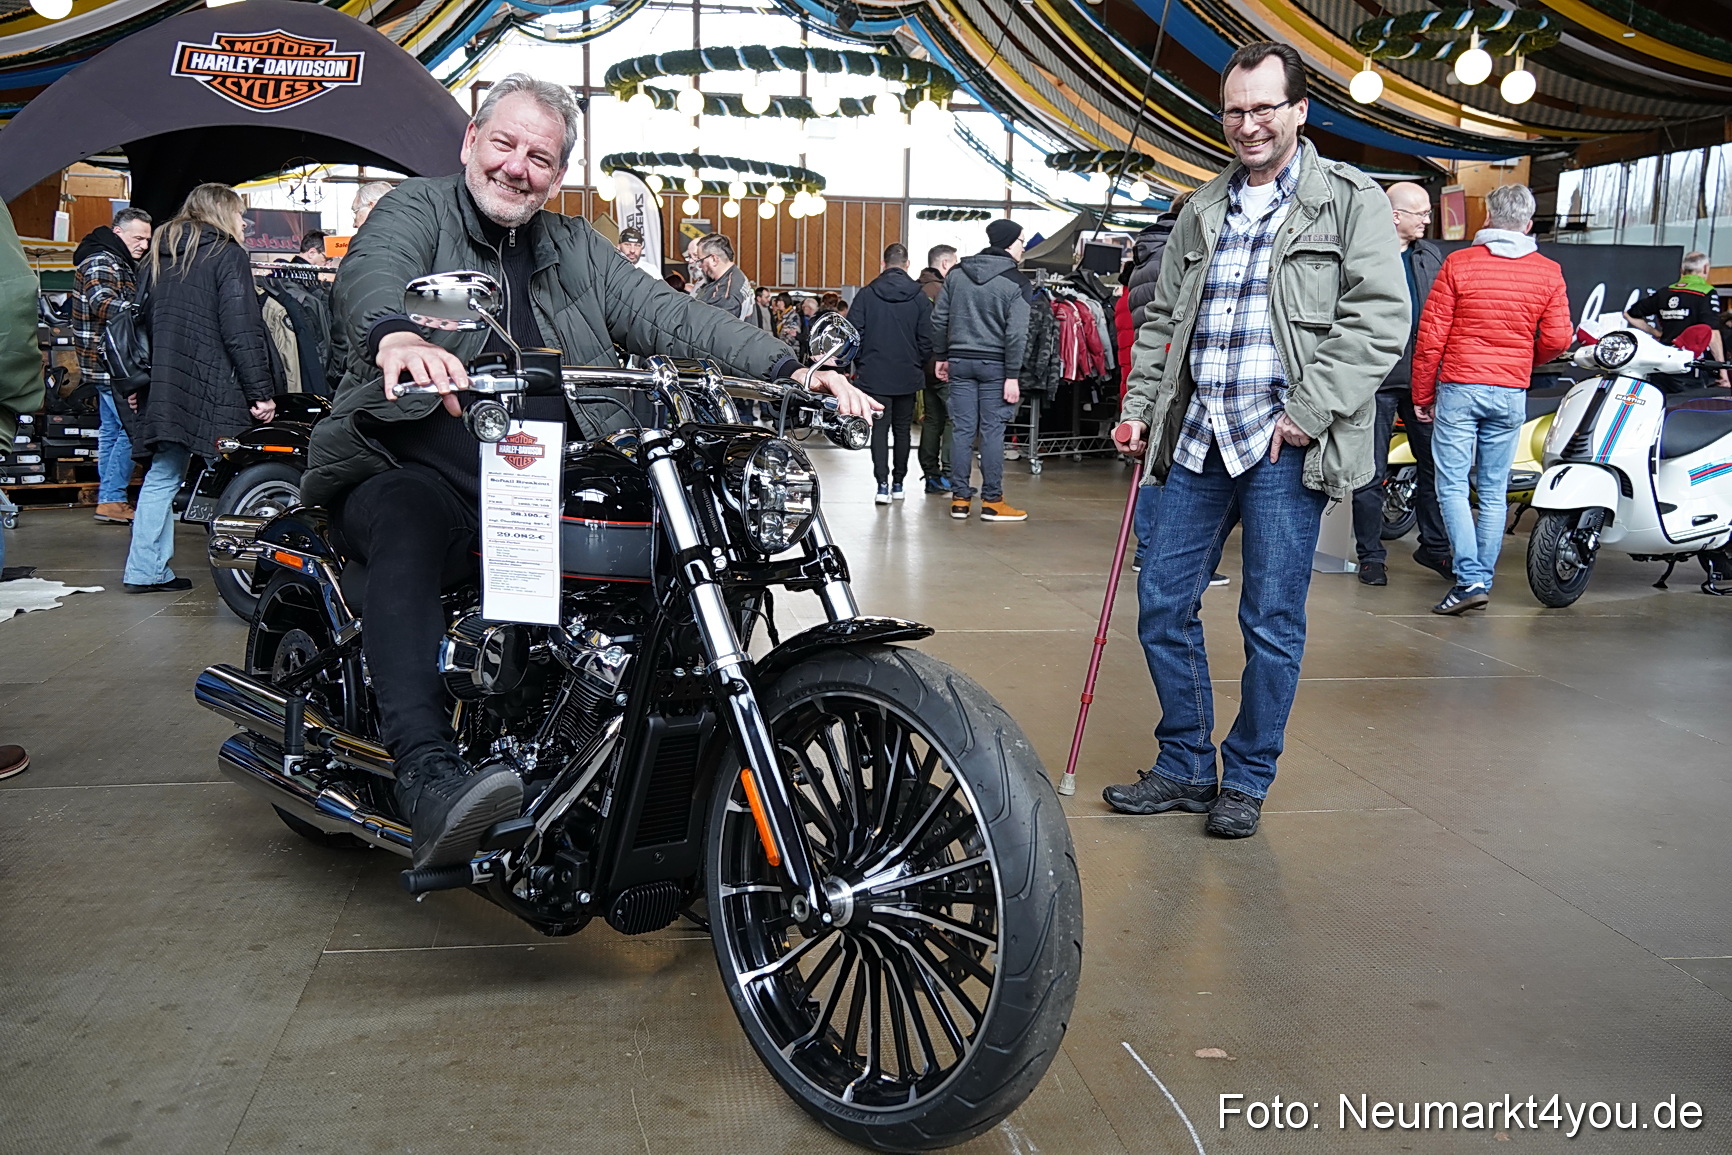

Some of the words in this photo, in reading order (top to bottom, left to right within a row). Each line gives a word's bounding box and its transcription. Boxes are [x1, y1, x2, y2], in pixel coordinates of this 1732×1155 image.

[233, 38, 317, 56] MOTOR
[190, 52, 348, 77] HARLEY-DAVIDSON
[225, 77, 309, 104] CYCLES
[1615, 394, 1646, 405] MARTINI
[509, 434, 533, 444] MOTOR
[508, 456, 533, 467] CYCLES
